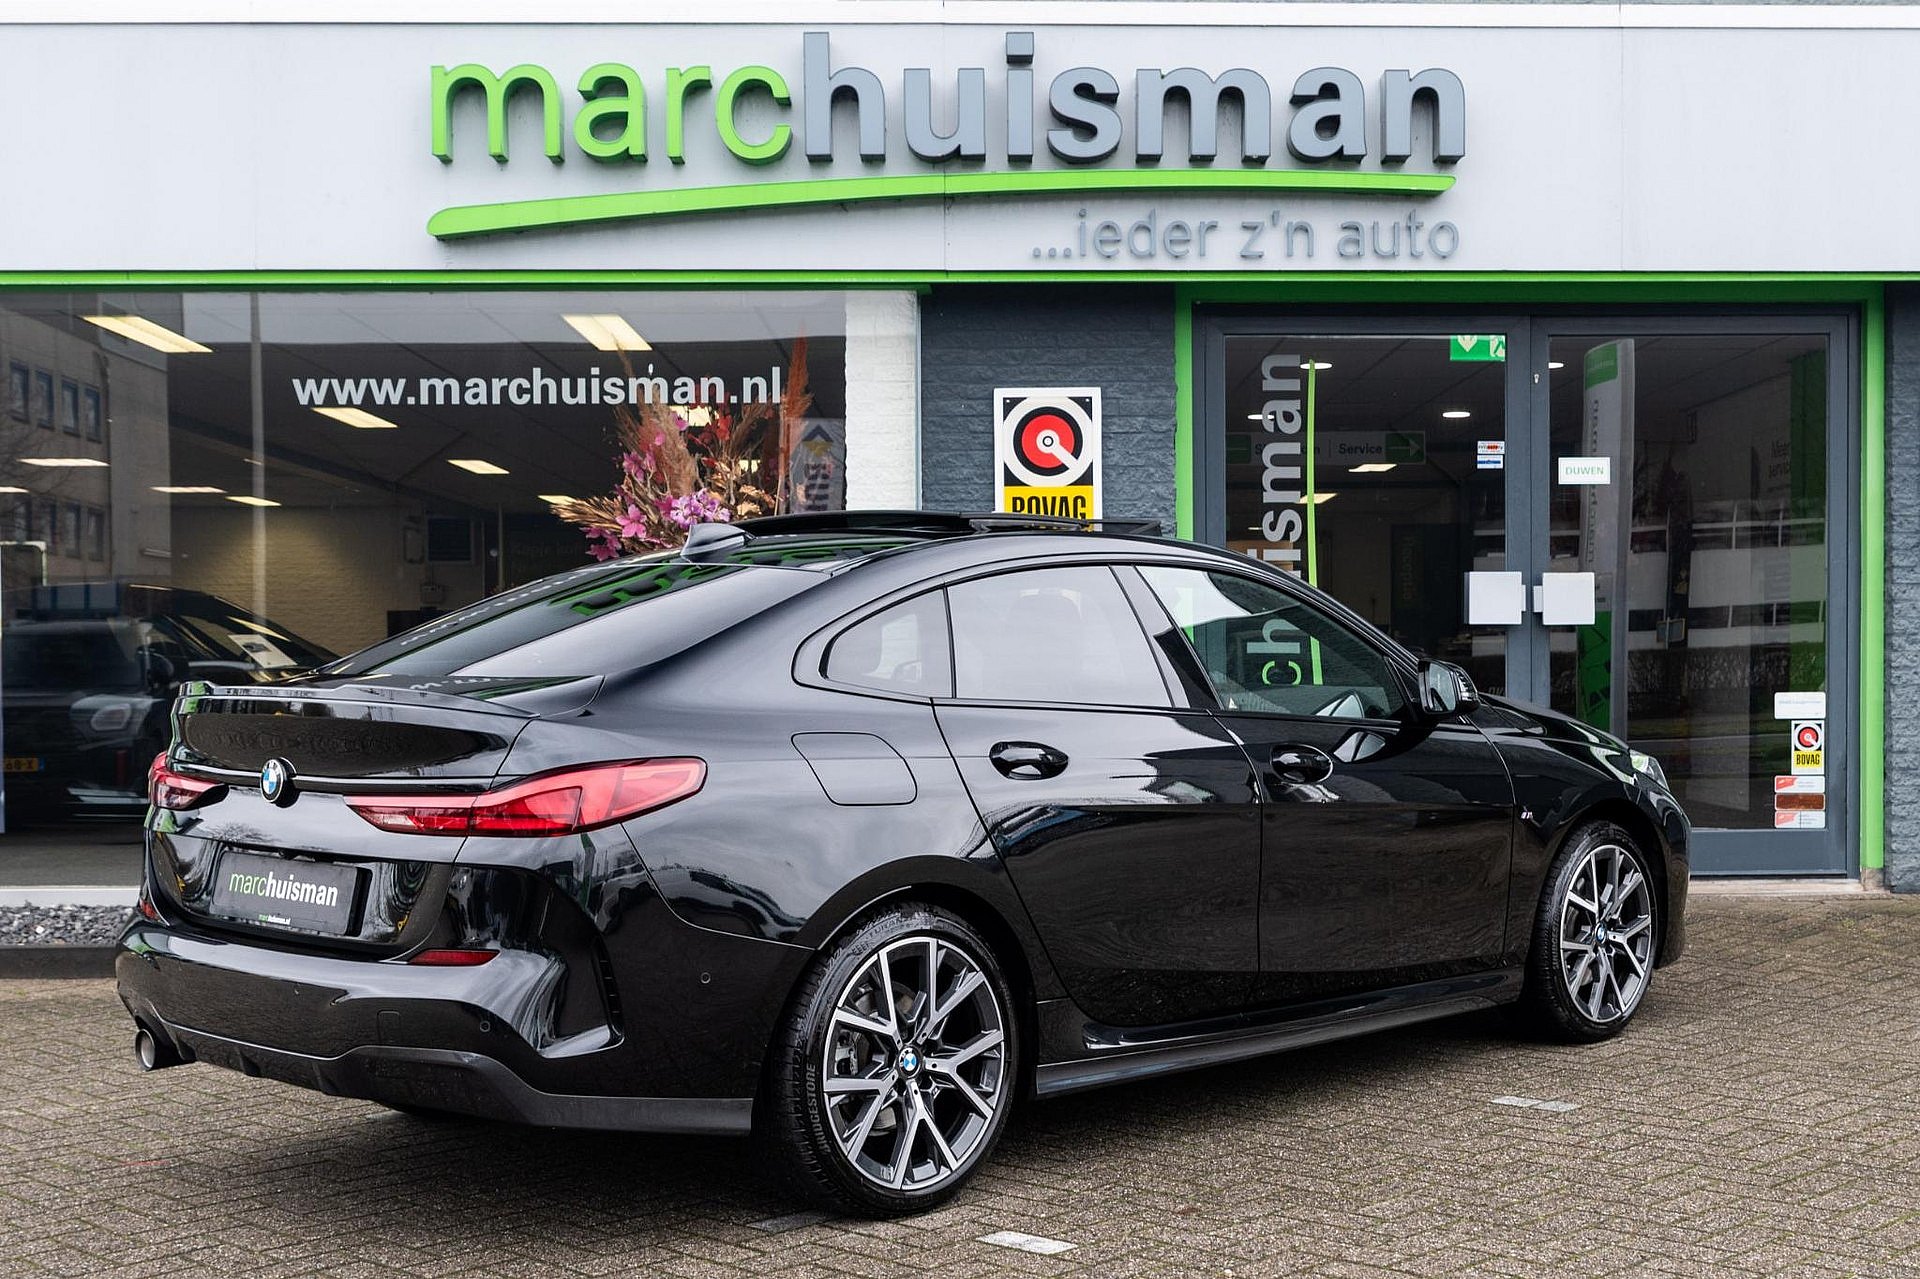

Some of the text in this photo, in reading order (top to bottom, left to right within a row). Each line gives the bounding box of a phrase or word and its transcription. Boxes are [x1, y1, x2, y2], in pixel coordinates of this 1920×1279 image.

[431, 32, 1466, 166] marchuisman
[1031, 210, 1460, 259] ...ieder z'n auto
[292, 366, 781, 405] www.marchuisman.nl
[1338, 444, 1383, 455] Service
[1565, 466, 1604, 475] DUWEN
[1796, 753, 1820, 765] BOVAG
[228, 871, 338, 907] marchuisman
